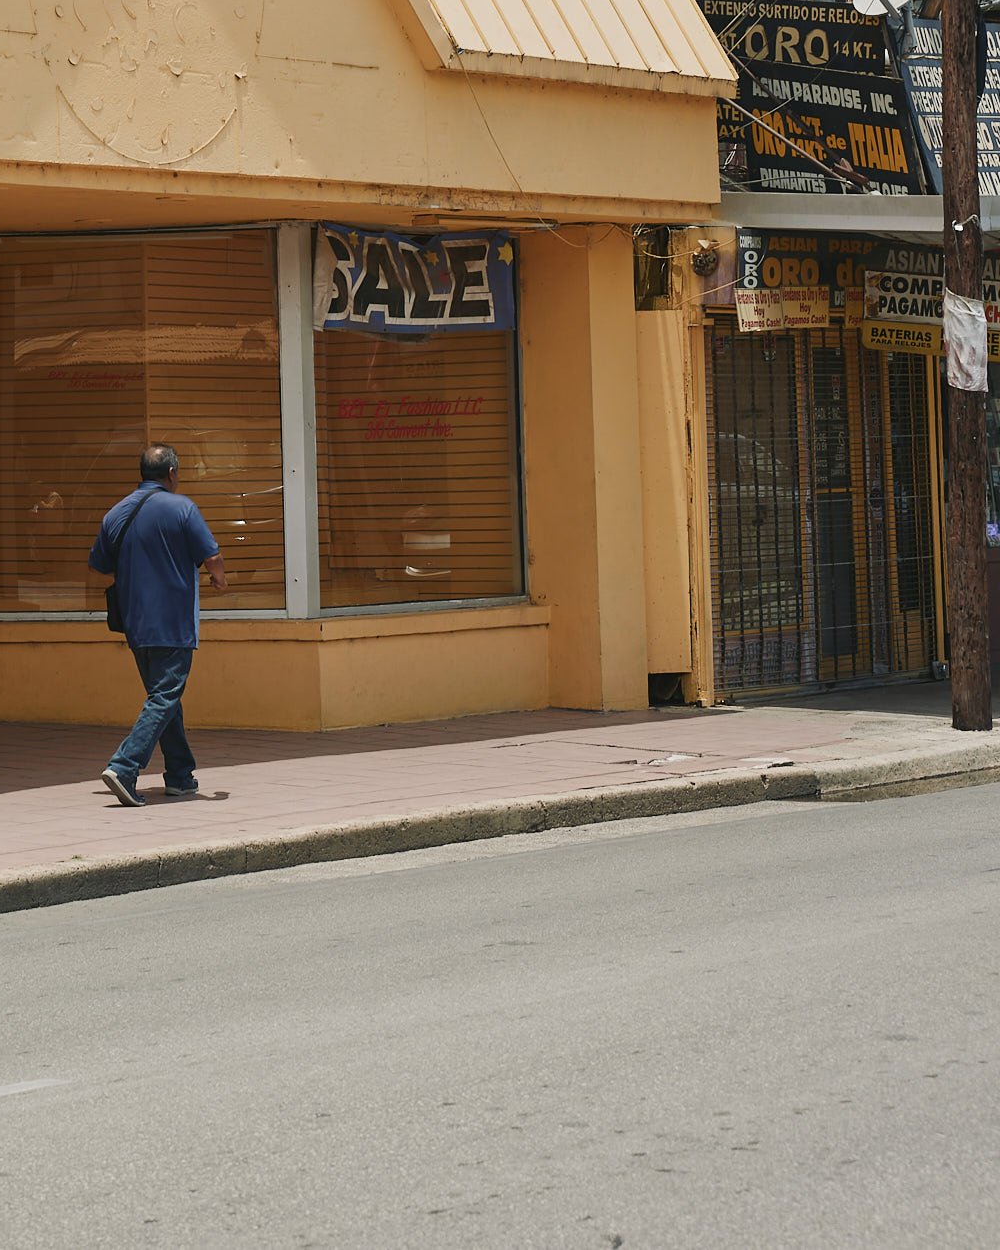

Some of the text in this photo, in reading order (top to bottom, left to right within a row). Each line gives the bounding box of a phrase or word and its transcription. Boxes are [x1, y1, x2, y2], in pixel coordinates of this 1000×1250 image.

[704, 0, 757, 17] EXTENSO
[758, 3, 808, 21] SURTIDO
[811, 7, 826, 22] DE
[745, 23, 829, 65] ORO
[752, 77, 792, 100] ASIAN
[870, 92, 898, 116] INC.
[752, 108, 786, 158] ORO
[826, 133, 847, 150] de
[847, 122, 909, 175] ITALIA
[759, 167, 827, 195] DIAMANTES
[768, 237, 818, 252] ASIAN
[743, 250, 759, 289] ORO
[762, 256, 819, 288] ORO
[884, 249, 941, 274] ASIAN
[326, 230, 496, 326] SALE
[753, 305, 765, 318] Hoy
[799, 302, 811, 315] Hoy
[784, 314, 810, 327] Pagamos
[871, 327, 932, 342] BATERIAS
[871, 337, 893, 346] PARA
[894, 339, 932, 349] RELOJES
[397, 395, 451, 417] Fashion
[454, 395, 485, 416] LLC
[387, 417, 431, 440] Convent
